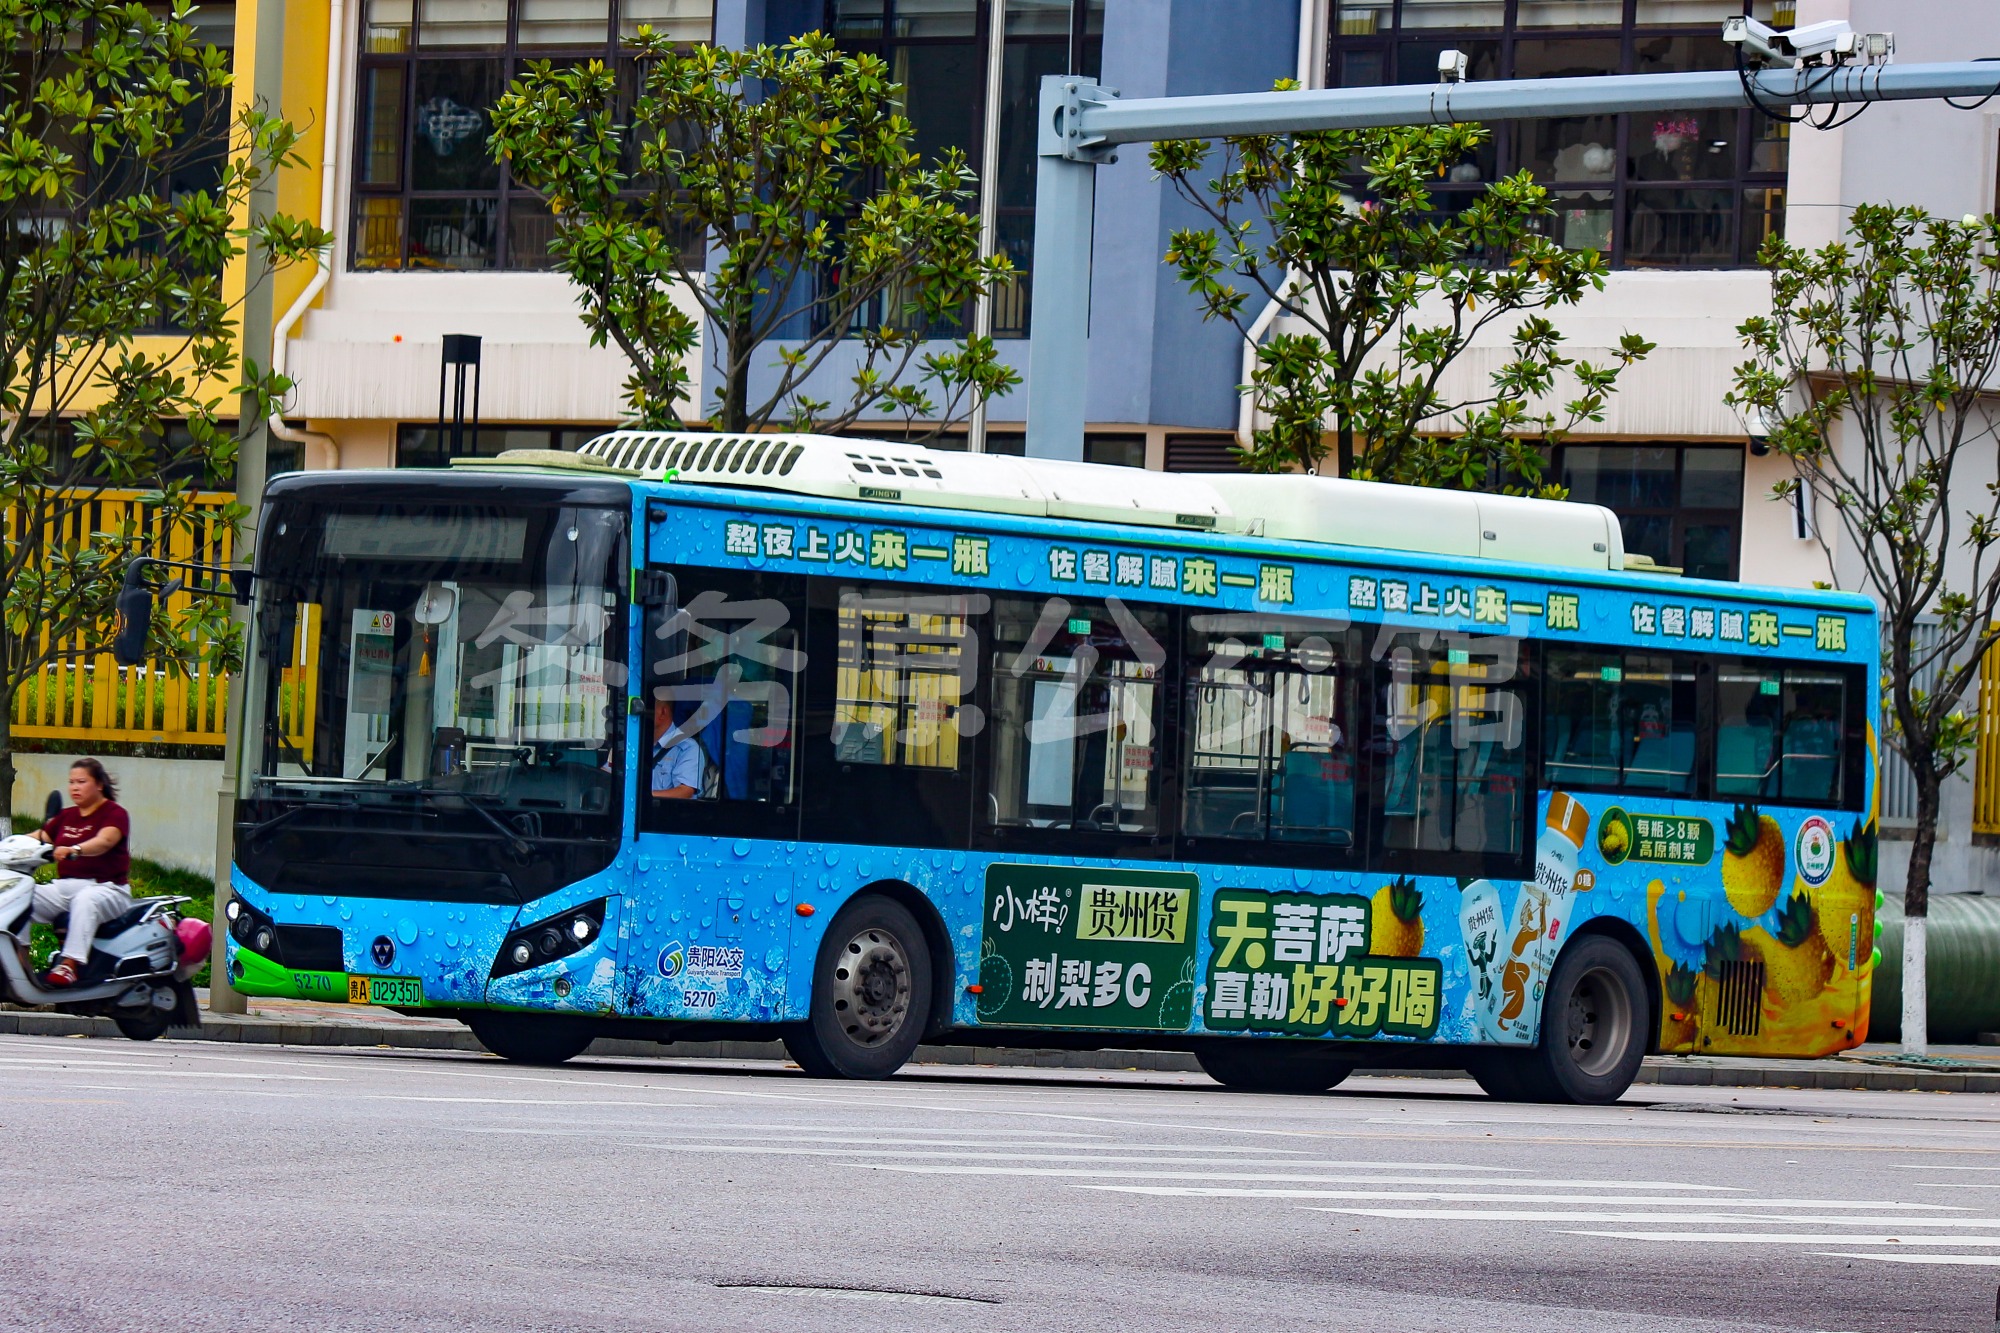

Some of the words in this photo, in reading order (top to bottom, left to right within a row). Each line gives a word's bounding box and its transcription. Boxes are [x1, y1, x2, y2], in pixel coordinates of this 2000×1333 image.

[725, 522, 989, 577] 熬夜上火来一瓶
[1049, 548, 1295, 602] 佐餐解腻来一瓶
[1348, 578, 1580, 630] 熬夜上火来一瓶
[1631, 604, 1847, 652] 佐餐解腻来一瓶
[1637, 819, 1700, 840] 每瓶≥8颗
[1640, 840, 1696, 860] 高原刺梨
[1535, 861, 1568, 900] 贵州货
[1088, 889, 1179, 941] 贵州货
[1216, 900, 1366, 969] 天菩萨
[1467, 905, 1495, 932] 贵州货
[686, 969, 705, 977] Guiyang
[719, 970, 741, 978] Transport
[687, 946, 744, 969] 贵阳公交
[294, 973, 332, 992] 5270
[683, 990, 716, 1008] 5270
[1022, 953, 1153, 1010] 刺梨多C
[1211, 964, 1437, 1028] 真勒好好喝
